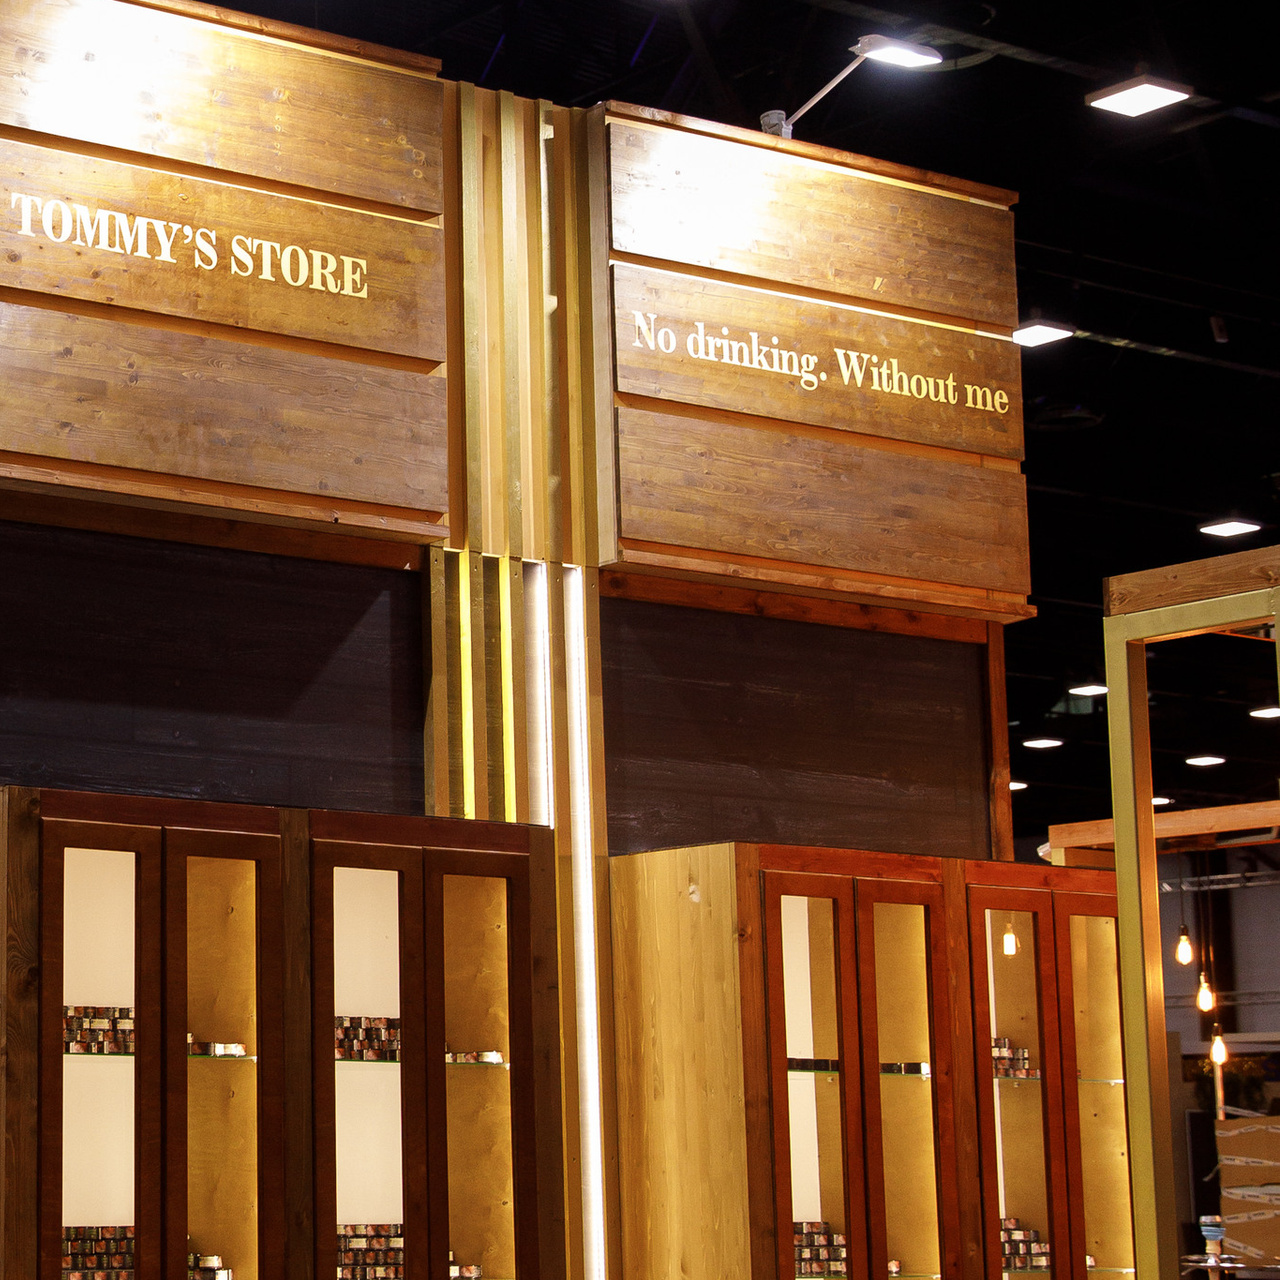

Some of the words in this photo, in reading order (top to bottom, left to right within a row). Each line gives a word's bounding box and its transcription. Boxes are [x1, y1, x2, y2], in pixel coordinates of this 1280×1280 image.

[11, 192, 218, 271] TOMMY'S
[230, 234, 368, 299] STORE
[631, 309, 677, 354] No
[685, 321, 828, 392] drinking.
[833, 347, 958, 406] Without
[964, 383, 1010, 414] me
